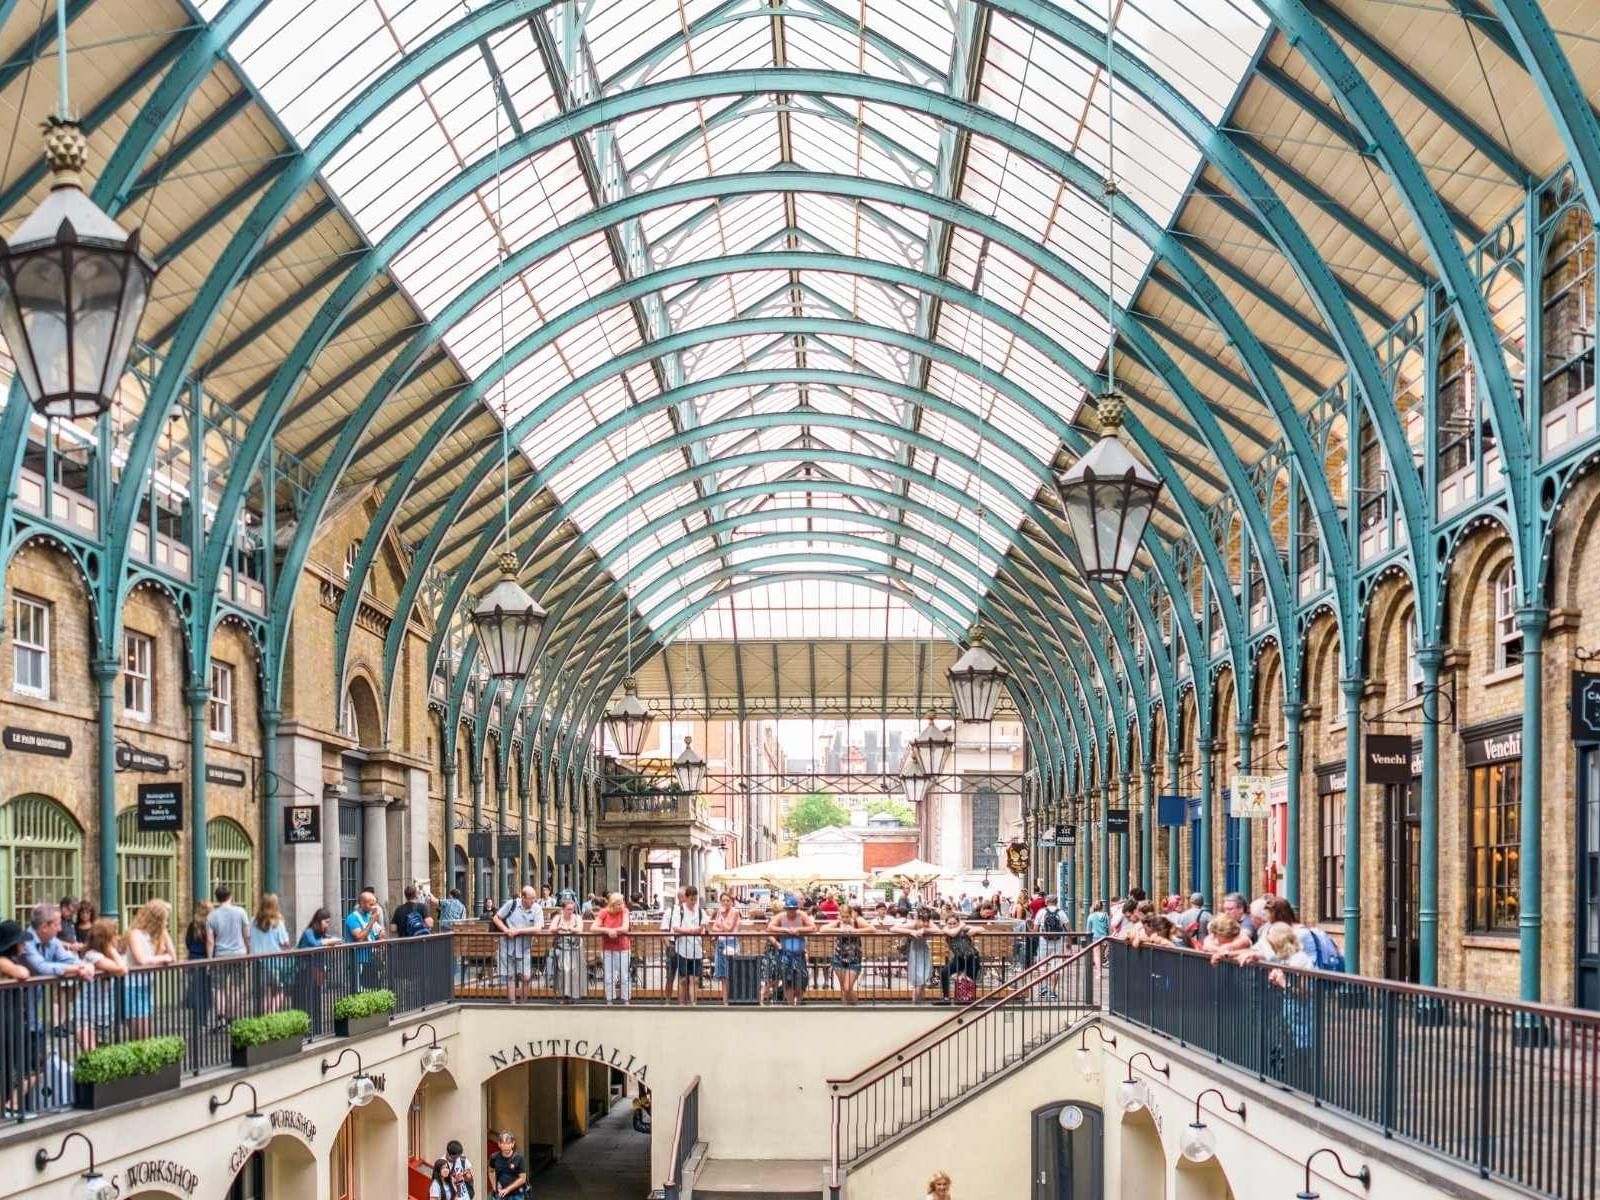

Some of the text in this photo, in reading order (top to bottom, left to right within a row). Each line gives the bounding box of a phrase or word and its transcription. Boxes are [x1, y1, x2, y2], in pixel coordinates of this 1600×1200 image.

[1371, 753, 1407, 765] Venchi
[1484, 732, 1520, 760] Venchi
[490, 1039, 648, 1081] NAUTICALIA
[269, 1109, 317, 1142] WORKSHOP
[127, 1160, 199, 1195] WORKSHOP
